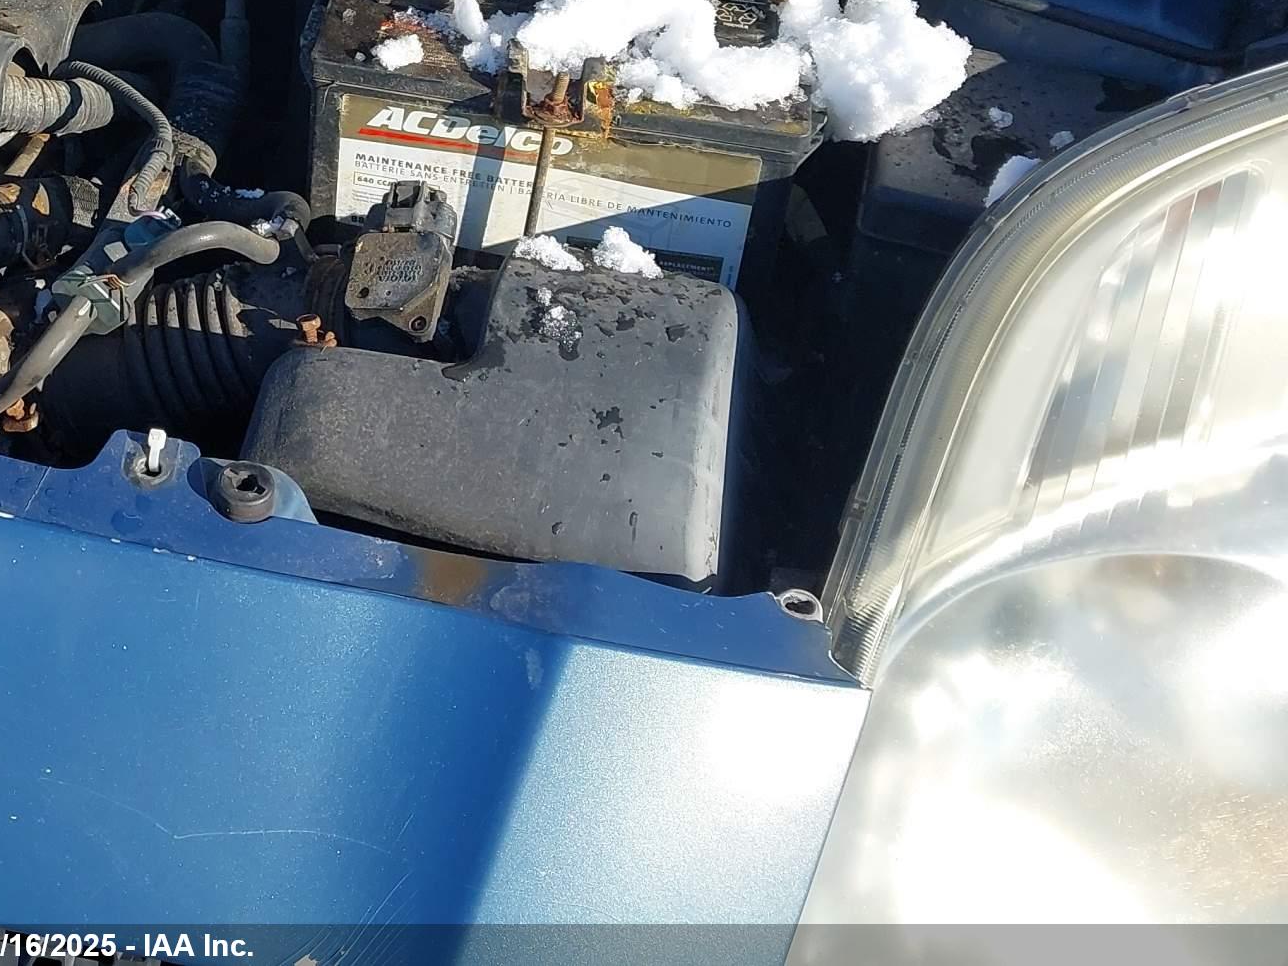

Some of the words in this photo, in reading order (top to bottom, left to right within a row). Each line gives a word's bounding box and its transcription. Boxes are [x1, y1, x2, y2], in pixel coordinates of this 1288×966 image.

[367, 106, 574, 155] ACDelco
[354, 160, 405, 176] BATTERIE
[410, 170, 439, 181] SANS
[570, 194, 603, 208] LIBRE
[607, 201, 623, 211] DE
[626, 205, 733, 229] MANTENIMIENTO
[355, 153, 448, 174] MAINTENANCE
[452, 168, 481, 182] FREE
[487, 174, 533, 188] BATTER
